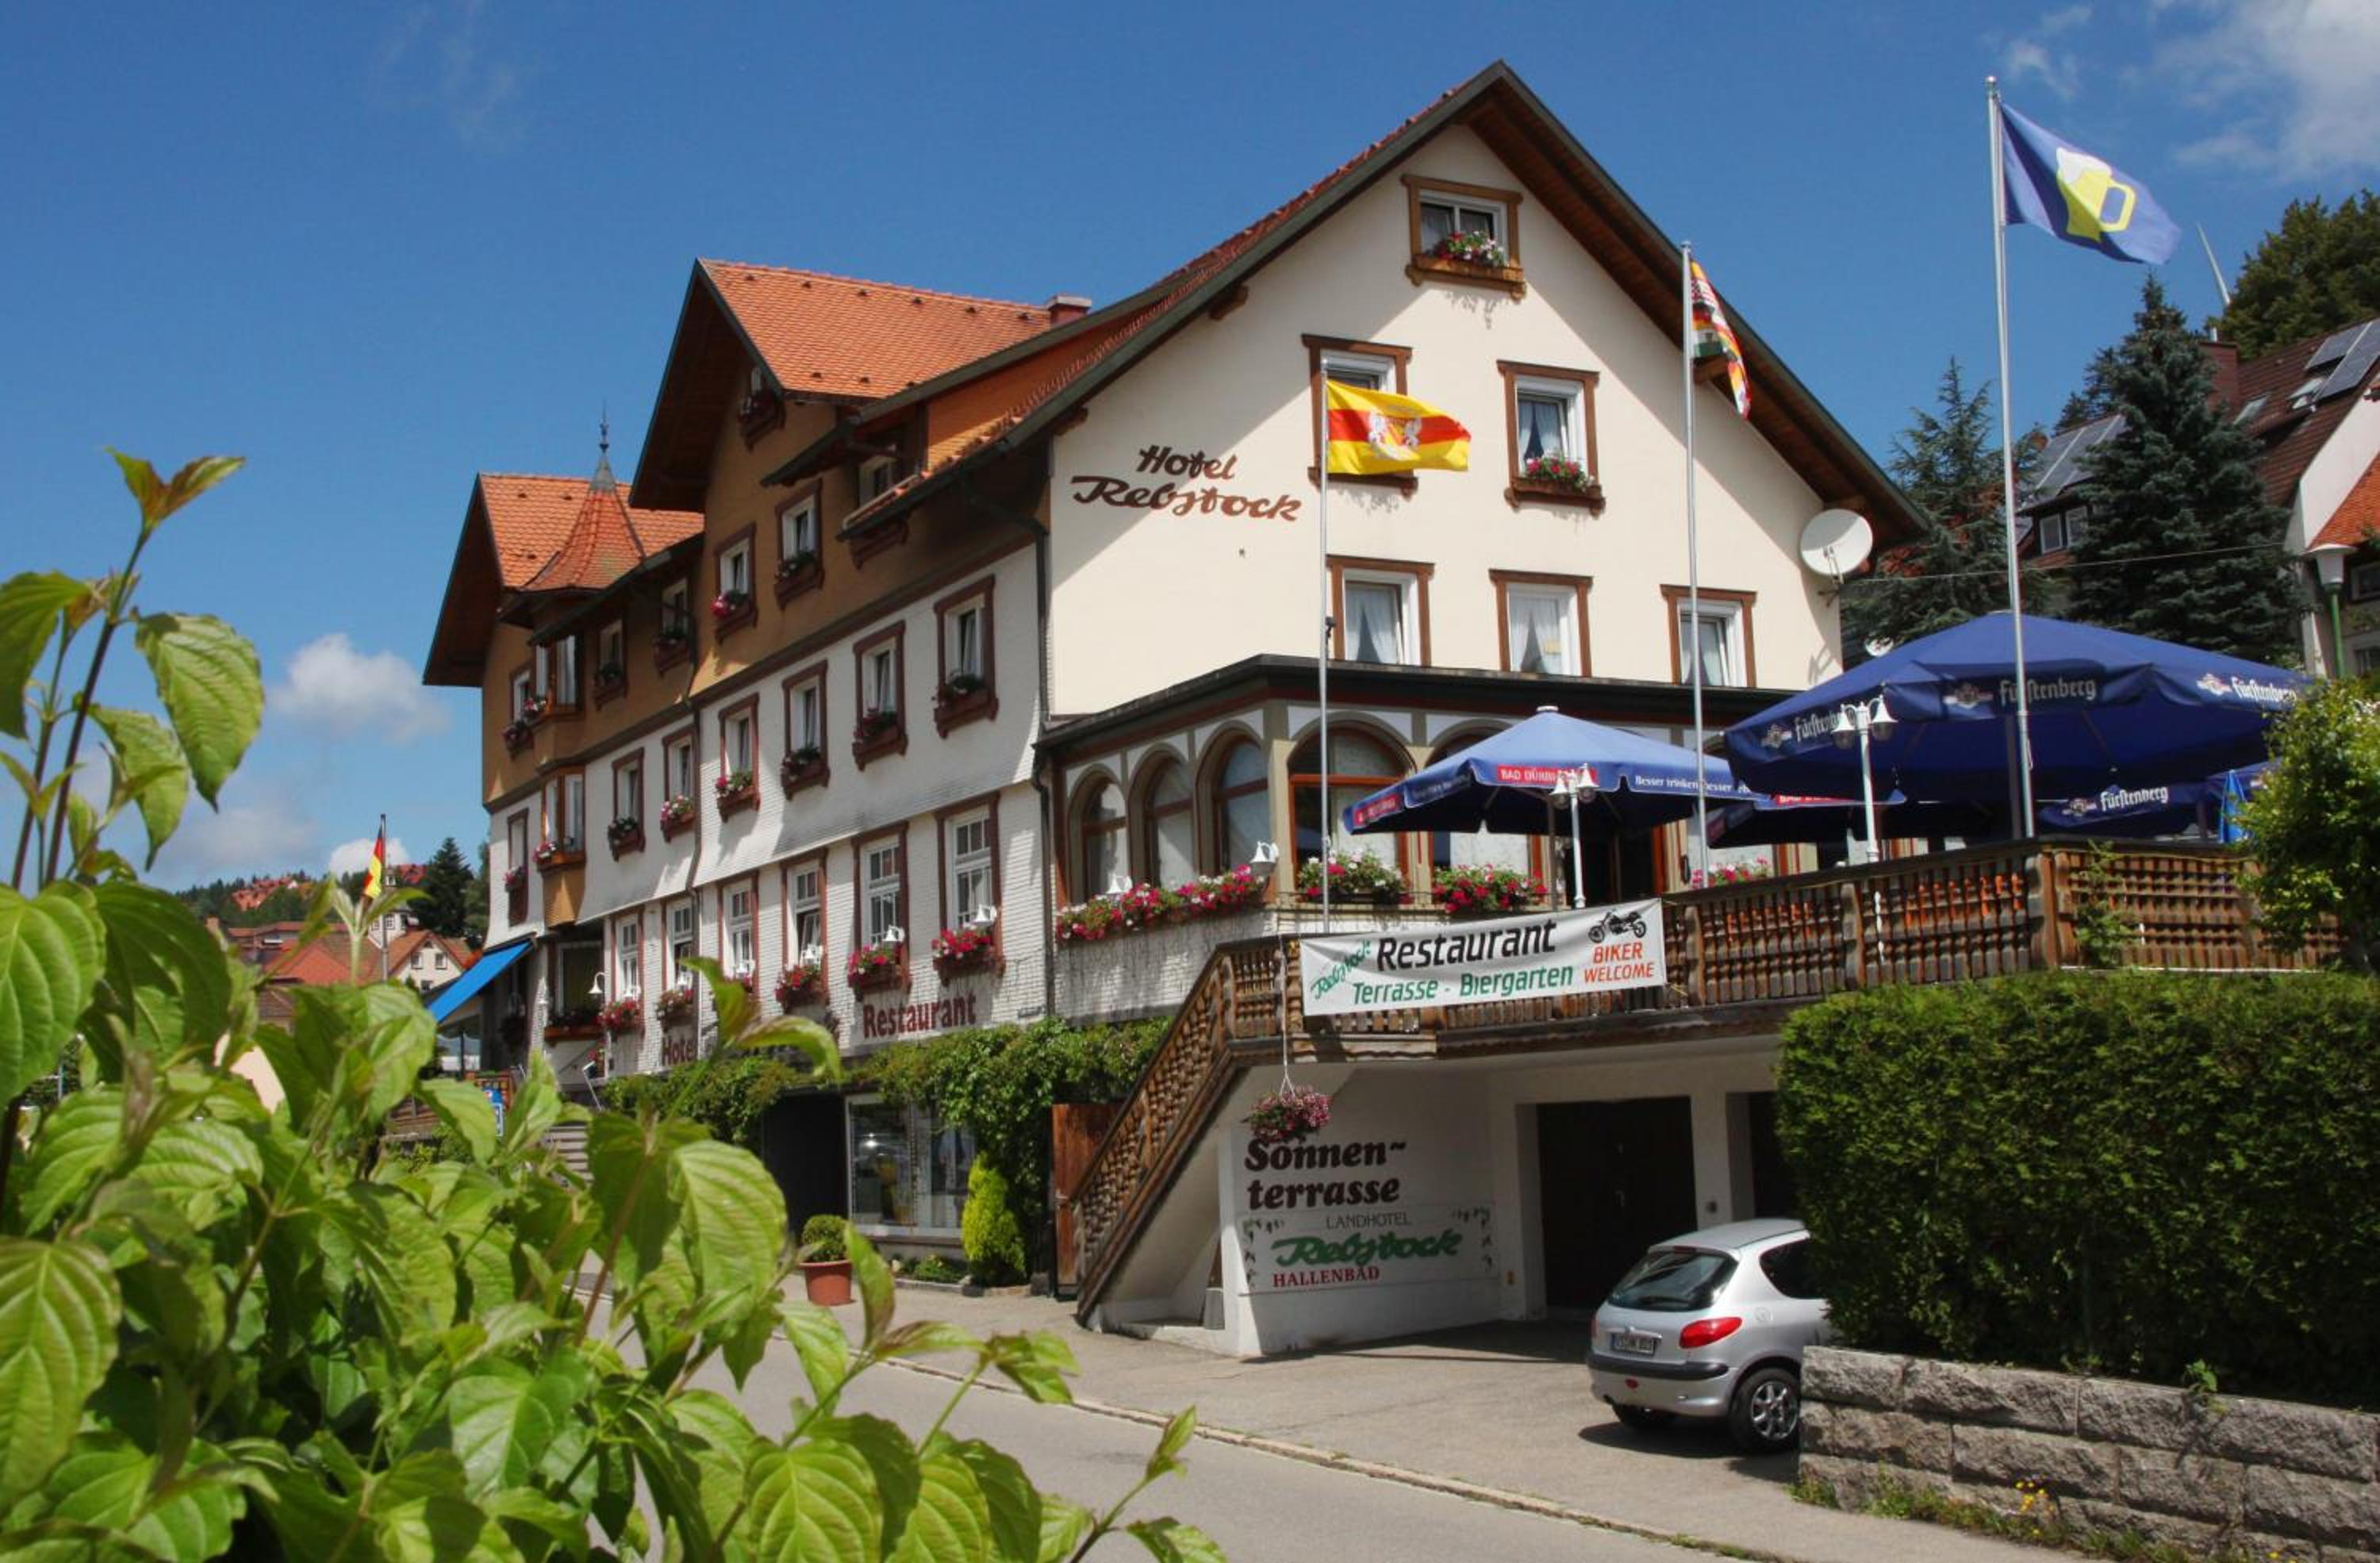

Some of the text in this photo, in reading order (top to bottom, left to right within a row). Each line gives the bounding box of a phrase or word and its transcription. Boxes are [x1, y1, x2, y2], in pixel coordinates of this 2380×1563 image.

[1136, 445, 1237, 479] Hotel
[1071, 476, 1301, 521] Rebstock
[1999, 677, 2097, 706] Füstenberg
[1635, 775, 1664, 787] Besser
[2100, 786, 2169, 812] Fürstenberg
[1376, 919, 1557, 972] Restaurant
[1592, 942, 1644, 964] BIKER
[1353, 978, 1439, 1005] Terrasse
[1460, 965, 1573, 997] Biergarten
[1584, 962, 1654, 984] WELCOME
[863, 995, 977, 1038] Restaurant
[662, 1035, 697, 1065] Hote
[1245, 1139, 1407, 1172] Sonnen-
[1247, 1178, 1400, 1211] terrasse
[1326, 1212, 1411, 1230] LANDHOTEL
[1271, 1230, 1463, 1267] Rebstock
[1273, 1266, 1380, 1288] HALLENBAD
